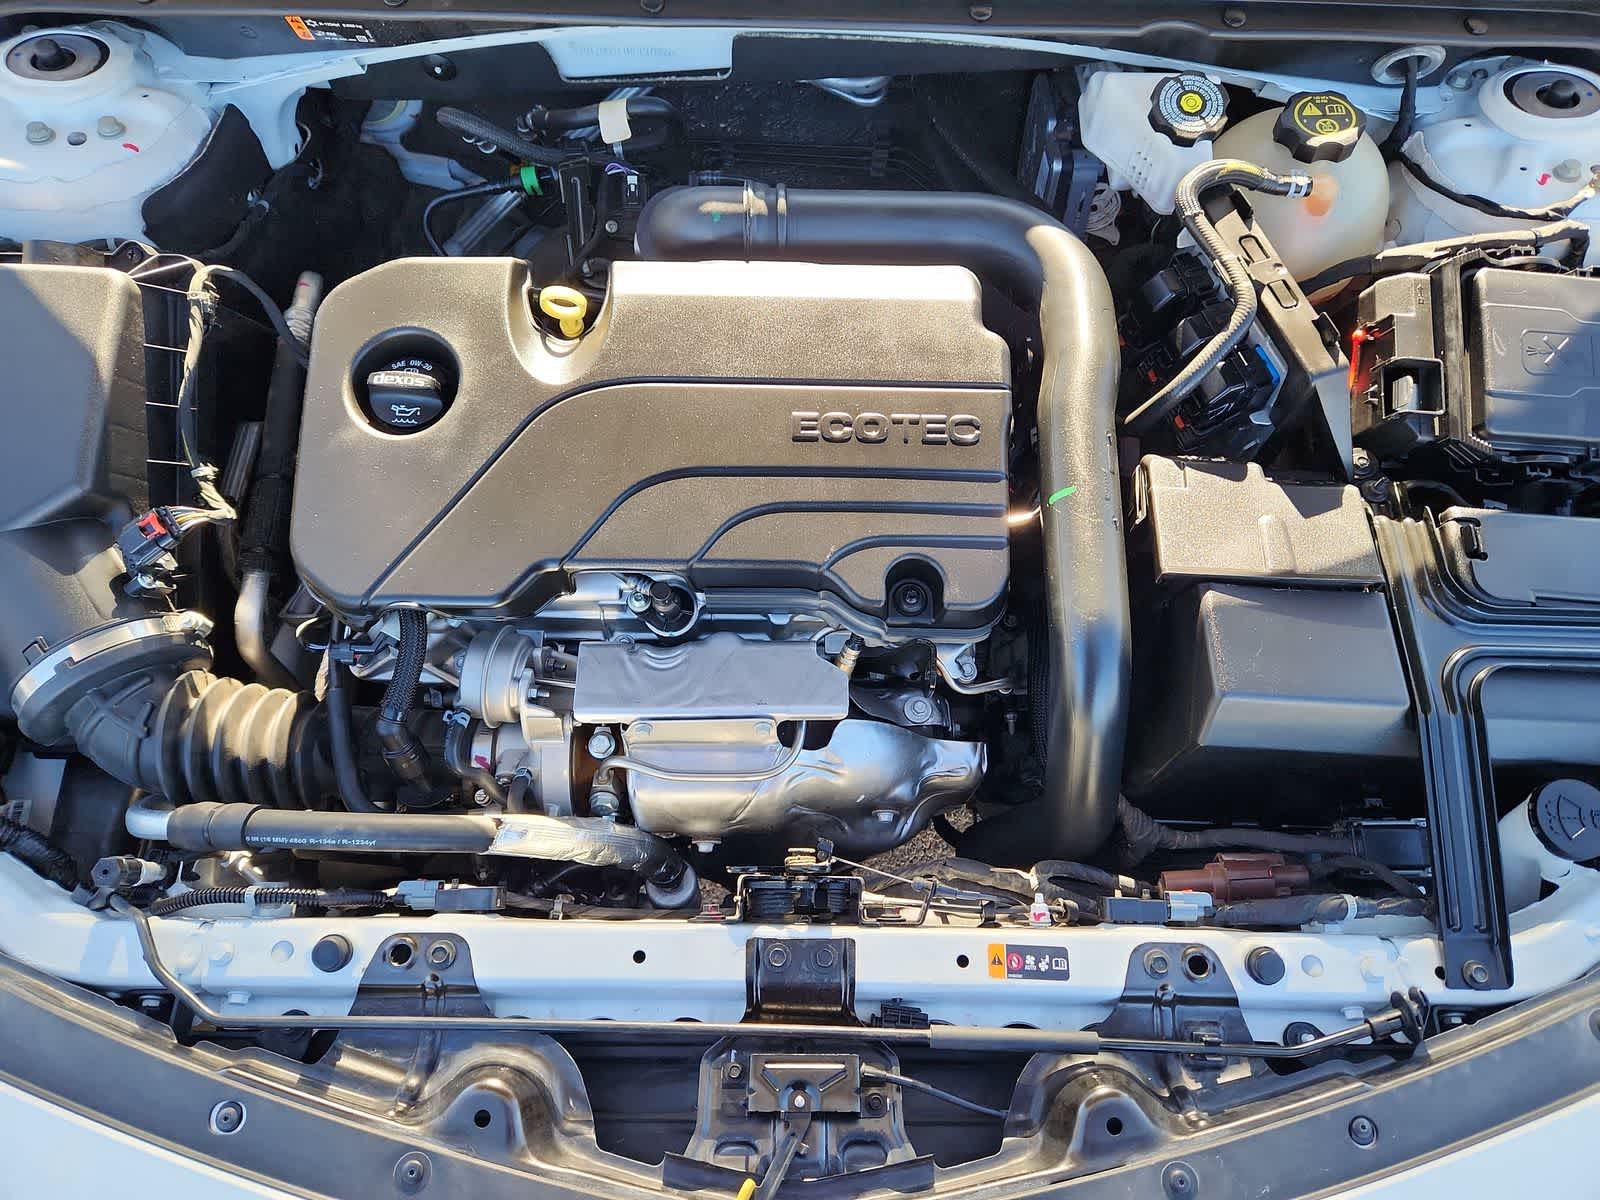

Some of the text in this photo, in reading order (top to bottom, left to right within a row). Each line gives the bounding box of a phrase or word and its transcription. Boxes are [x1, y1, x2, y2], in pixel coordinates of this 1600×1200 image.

[391, 359, 433, 371] SAE 0W-20
[373, 373, 425, 387] dexos
[791, 411, 981, 446] ECOTEC
[341, 839, 377, 847] R-1234yf
